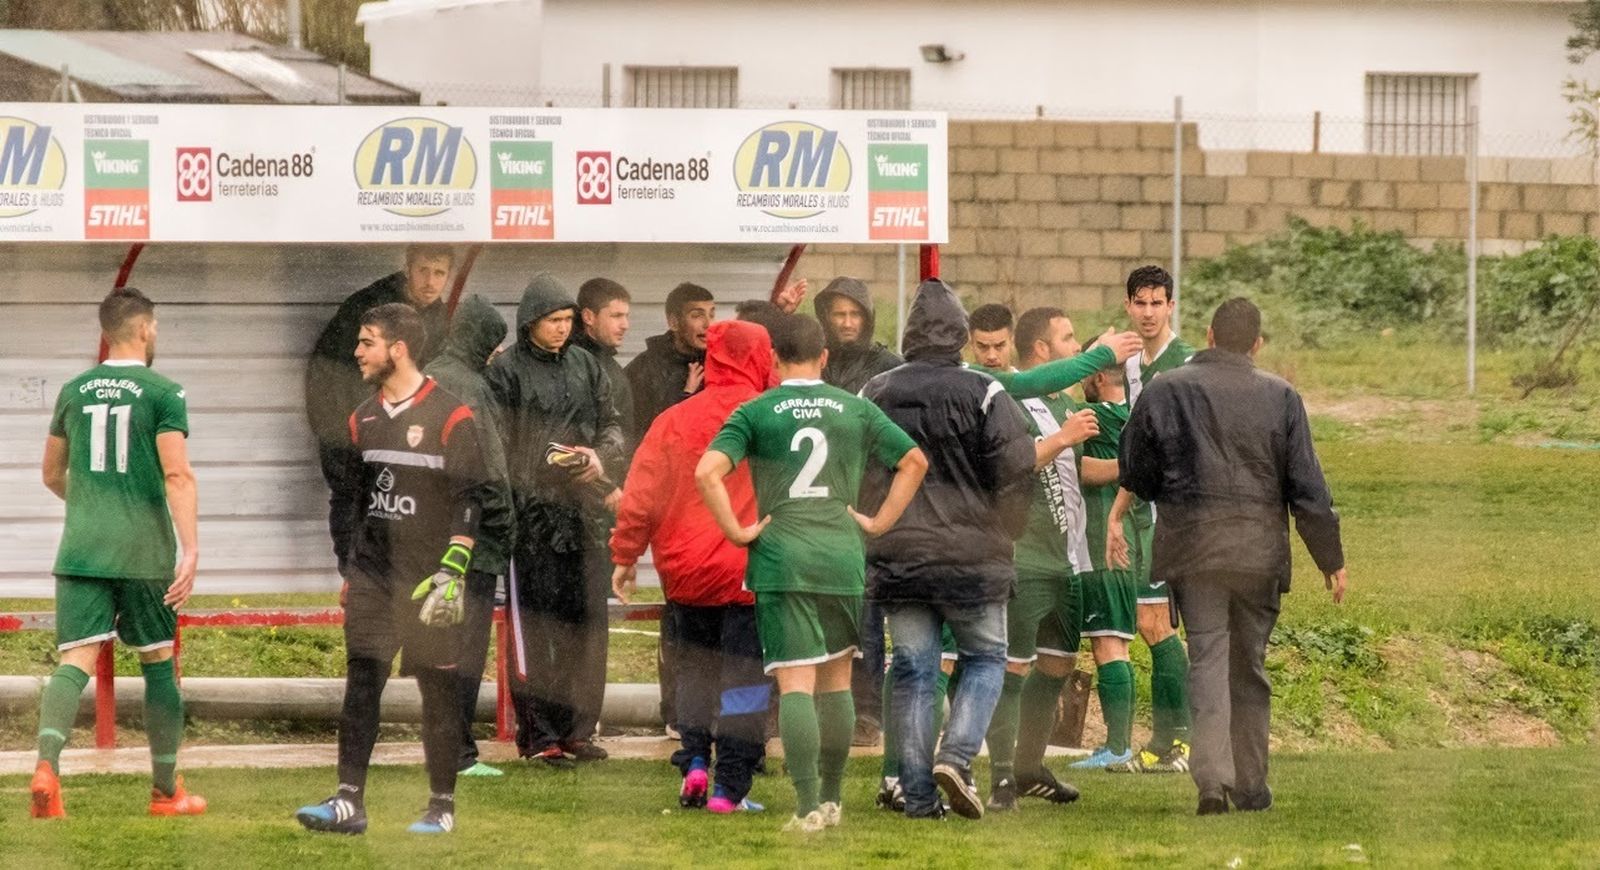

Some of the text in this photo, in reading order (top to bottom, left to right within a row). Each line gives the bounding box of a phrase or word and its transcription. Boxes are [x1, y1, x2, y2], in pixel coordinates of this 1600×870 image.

[217, 152, 314, 177] Cadena 88
[370, 127, 463, 185] RM
[749, 130, 838, 187] RM
[94, 159, 140, 174] VIKING
[500, 159, 543, 175] VIKING
[616, 156, 710, 181] Cadena 88
[877, 160, 919, 176] VIKING
[358, 191, 404, 206] RECAMBIOS
[405, 191, 444, 206] MORALES
[736, 193, 780, 208] RECAMBIOS
[782, 193, 819, 208] MORALES
[827, 194, 850, 208] HIJOS
[88, 204, 146, 227] STIHL
[495, 205, 550, 226] STIHL
[871, 206, 926, 227] STIHL
[79, 378, 143, 397] CERRAJERIA
[95, 388, 121, 399] CIVA
[773, 397, 844, 414] CERRAJERIA
[792, 408, 822, 419] CIVA
[82, 403, 131, 473] 11
[788, 426, 829, 499] 2
